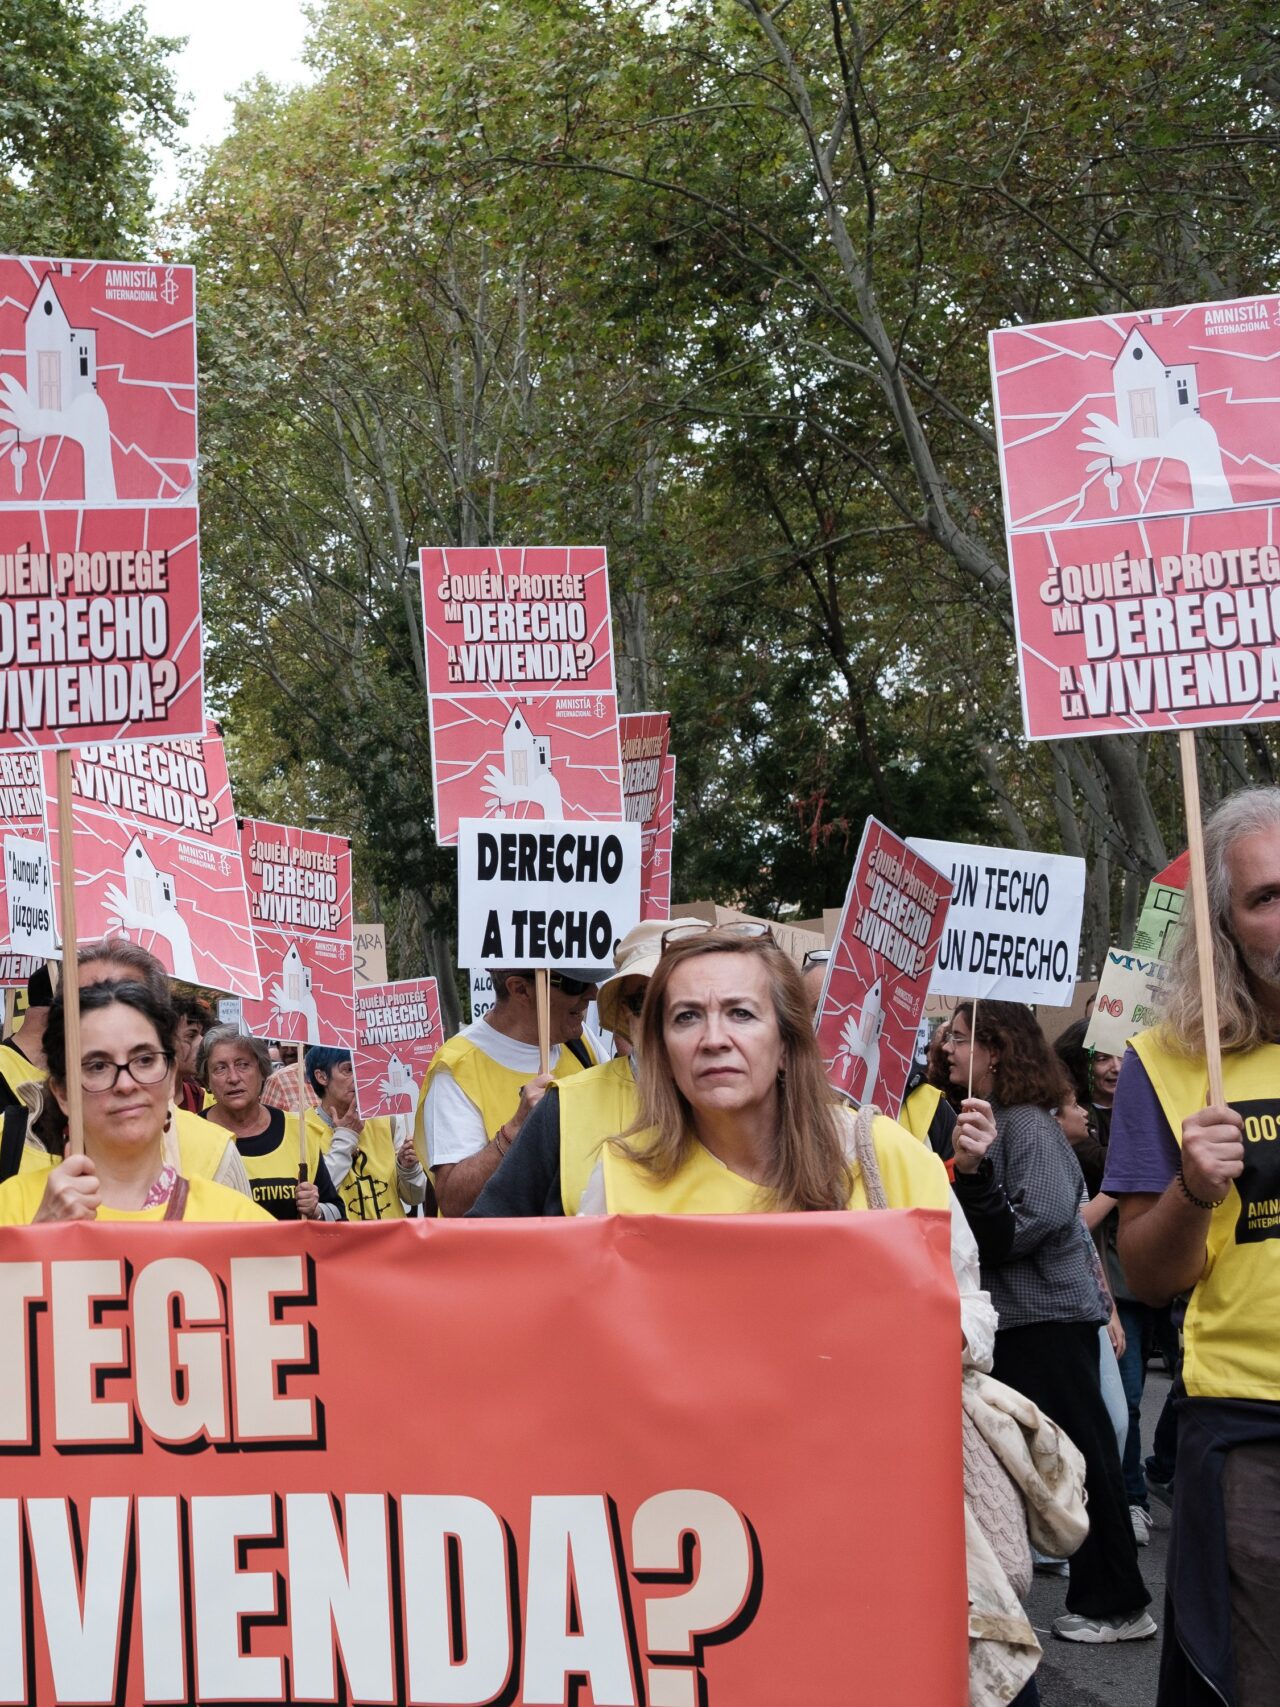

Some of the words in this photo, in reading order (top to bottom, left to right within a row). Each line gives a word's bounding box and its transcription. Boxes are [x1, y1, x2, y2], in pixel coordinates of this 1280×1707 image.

[106, 267, 157, 288] AMNISTÍA
[106, 289, 158, 302] INTERNACIONAL
[1204, 302, 1269, 325] AMNISTÍA
[1205, 320, 1270, 336] INTERNACIONAL
[57, 550, 169, 596] PROTEGE
[438, 568, 504, 602] ¿QUIÉN
[507, 574, 586, 600] PROTEGE
[1039, 550, 1157, 605] ¿QUIÉN
[1160, 545, 1280, 594] PROTEG
[445, 602, 463, 623] MI
[462, 602, 587, 643] DERECHO
[1051, 605, 1084, 635] MI
[448, 645, 459, 665] A
[460, 643, 595, 683] VIVIENDA?
[448, 665, 464, 683] LA
[1059, 665, 1077, 693] A
[555, 697, 591, 711] AMNISTÍA
[556, 710, 592, 718] INTERNACIONAL
[1061, 693, 1089, 720] LA
[624, 757, 660, 795] DERECHO
[75, 761, 218, 836] VIVIENDA?
[178, 843, 216, 863] AMNISTÍA
[179, 854, 217, 872] INTERNACIONAL
[249, 839, 290, 866] ¿QUIÉN
[292, 847, 337, 874] PROTEGE
[477, 833, 623, 884] DERECHO
[8, 850, 42, 885] "Aunque"
[867, 845, 903, 887] ¿QUIÉN
[901, 869, 939, 915] PROTEGE
[252, 861, 263, 876] MI
[262, 863, 337, 903] DERECHO
[951, 863, 979, 907] UN
[984, 867, 1049, 916] TECHO
[252, 892, 260, 905] A
[252, 905, 261, 919] LA
[865, 869, 875, 889] MI
[870, 876, 933, 948] DERECHO
[11, 896, 49, 937] júzgues
[259, 893, 342, 932] VIVIENDA?
[856, 905, 863, 920] A
[481, 910, 503, 958] A
[852, 921, 862, 940] LA
[860, 909, 927, 982] VIVIENDA?
[938, 928, 966, 971] UN
[969, 931, 1072, 983] DERECHO.
[474, 977, 492, 991] ALQ
[387, 989, 427, 1008] PROTEGE
[1098, 994, 1124, 1018] NO
[357, 1010, 366, 1021] MI
[365, 1002, 429, 1028] DERECHO
[365, 1020, 433, 1046] VIVIENDA?
[252, 1185, 295, 1201] CTIVIST
[1248, 1199, 1280, 1218] AMN
